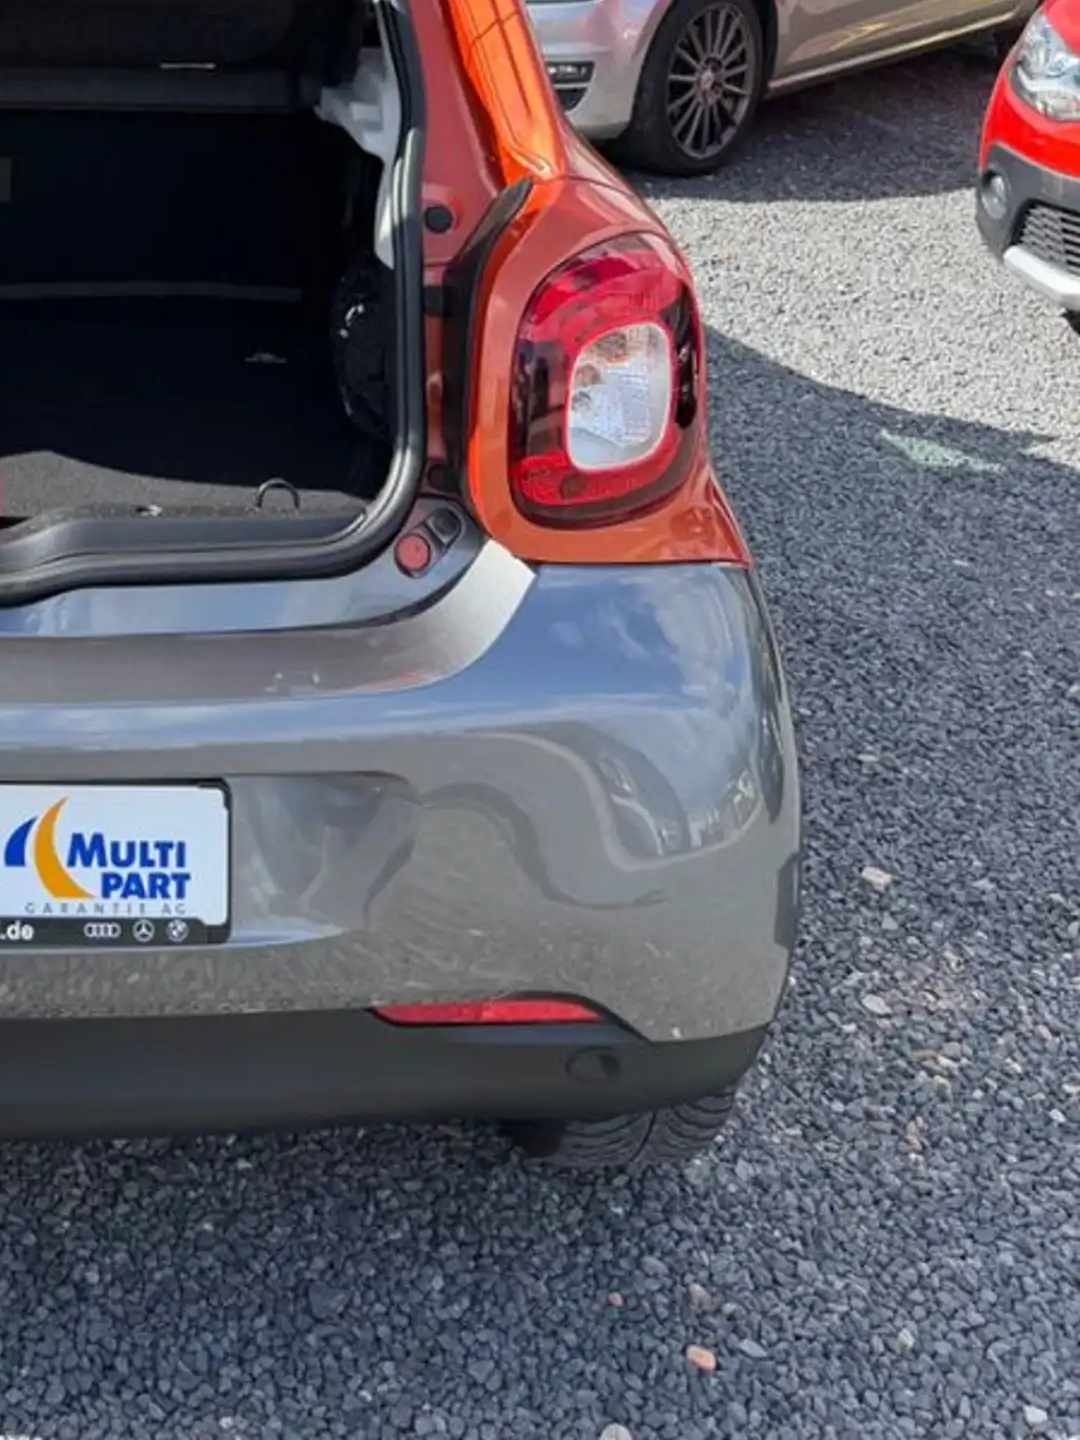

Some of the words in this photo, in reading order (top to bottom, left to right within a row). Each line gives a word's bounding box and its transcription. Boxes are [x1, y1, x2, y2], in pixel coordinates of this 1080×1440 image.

[101, 872, 191, 899] PART
[25, 902, 145, 915] GARANTIE
[161, 903, 186, 915] AG
